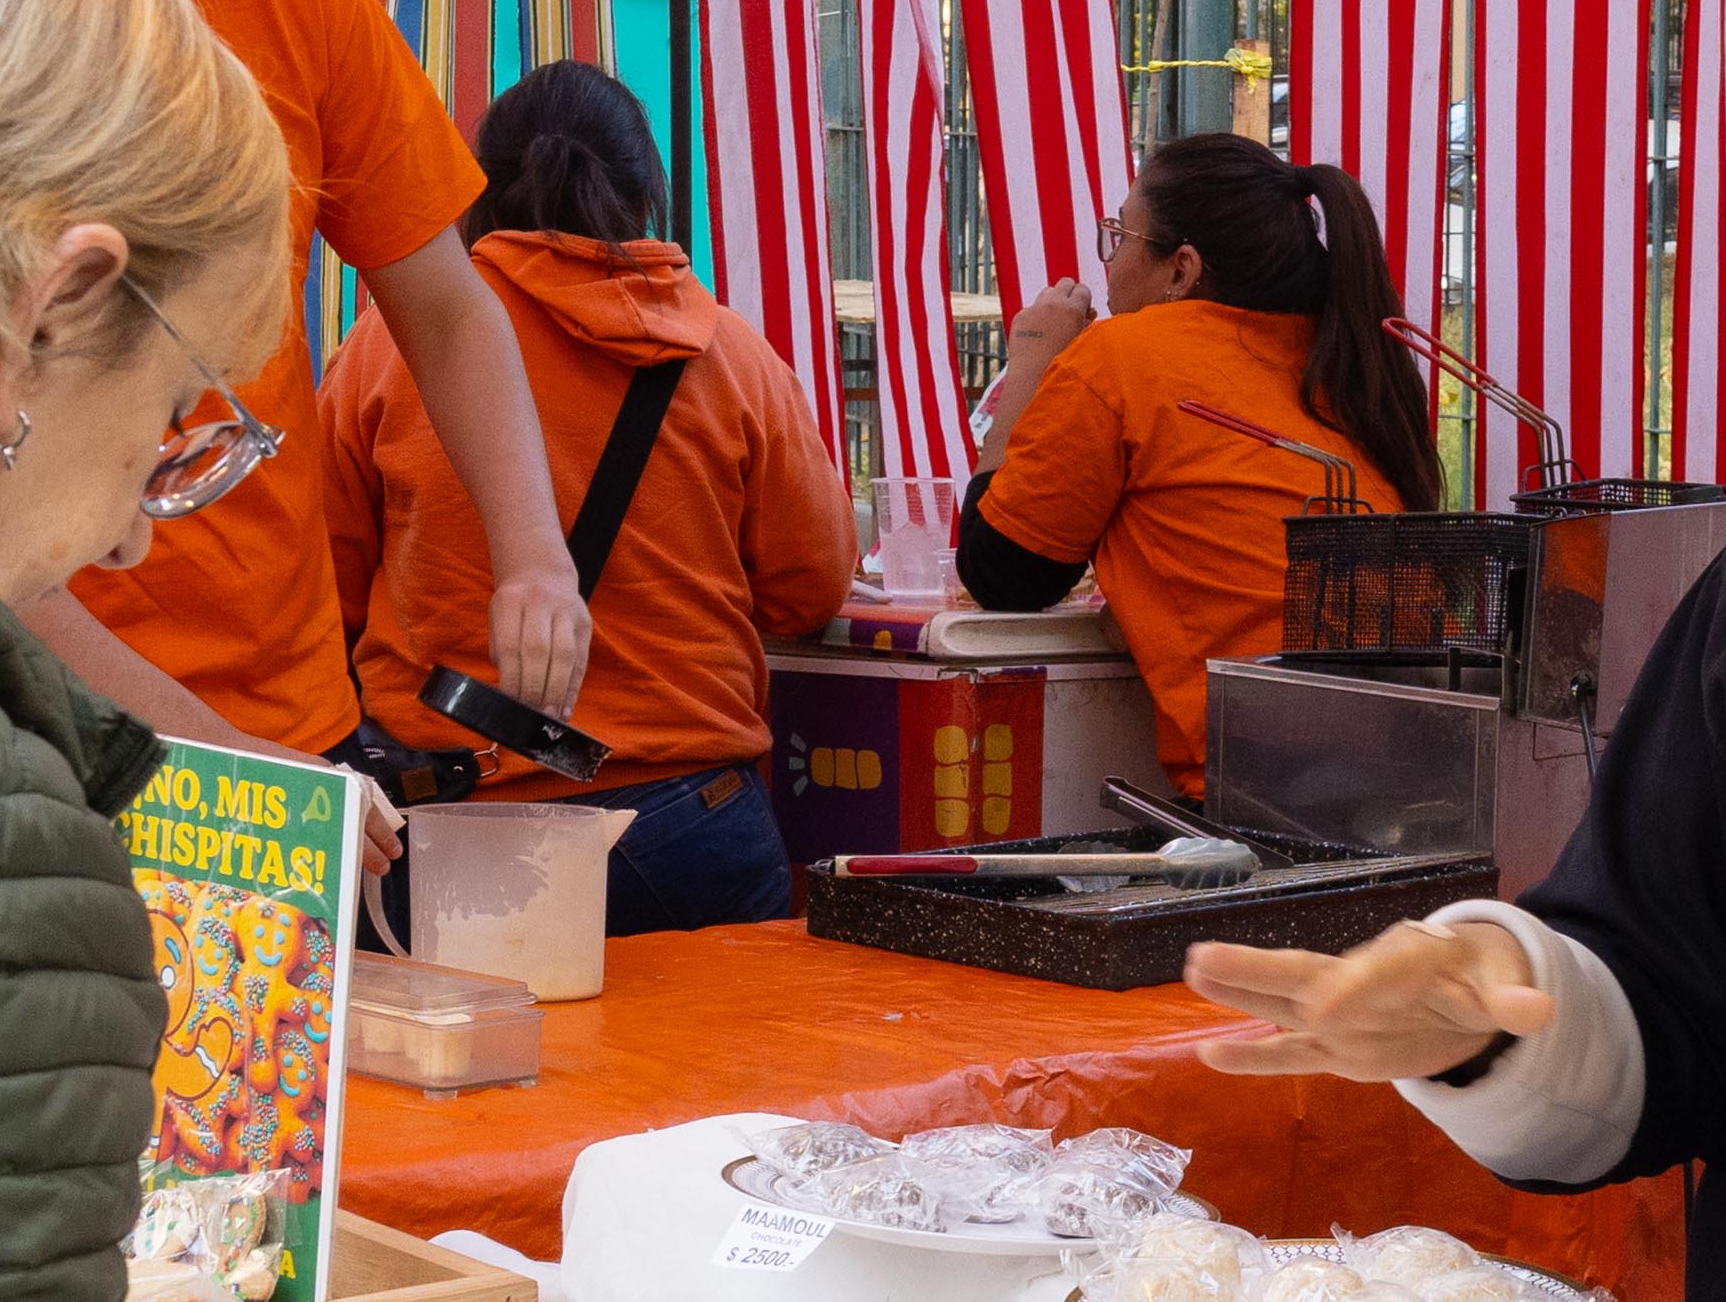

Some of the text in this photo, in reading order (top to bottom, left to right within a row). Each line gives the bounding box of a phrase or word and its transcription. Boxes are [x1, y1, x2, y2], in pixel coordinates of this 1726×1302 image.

[214, 776, 287, 829] MIS
[741, 1208, 826, 1238] MAAMOUL
[726, 1246, 740, 1262] $
